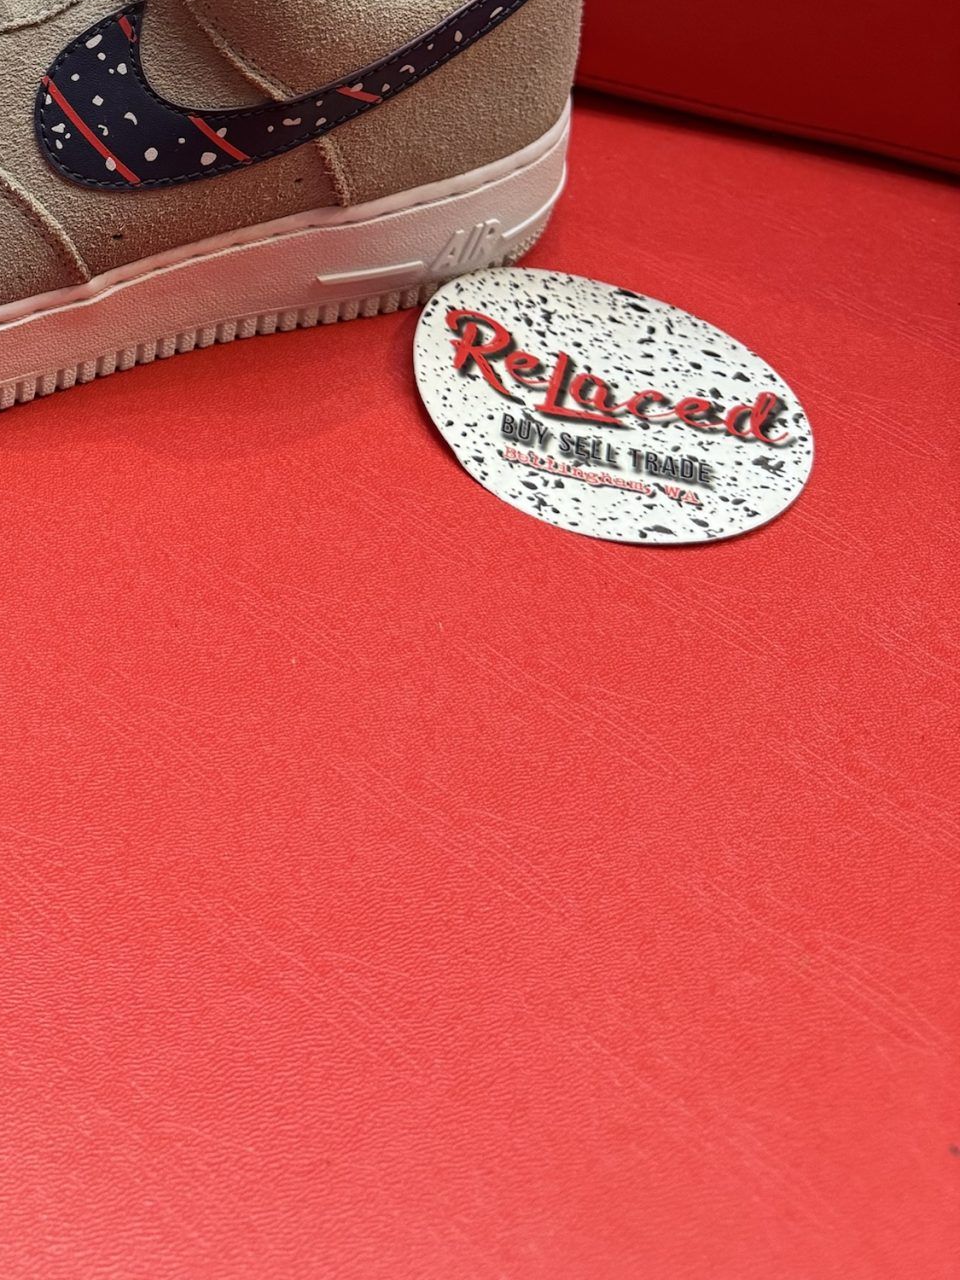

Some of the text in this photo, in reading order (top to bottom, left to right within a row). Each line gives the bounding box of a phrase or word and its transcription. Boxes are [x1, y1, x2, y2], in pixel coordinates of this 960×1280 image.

[430, 218, 501, 273] AIR
[444, 309, 789, 444] ReLaced
[501, 412, 713, 484] BUY SELL TRADE
[503, 445, 700, 504] Bellingham, WA
